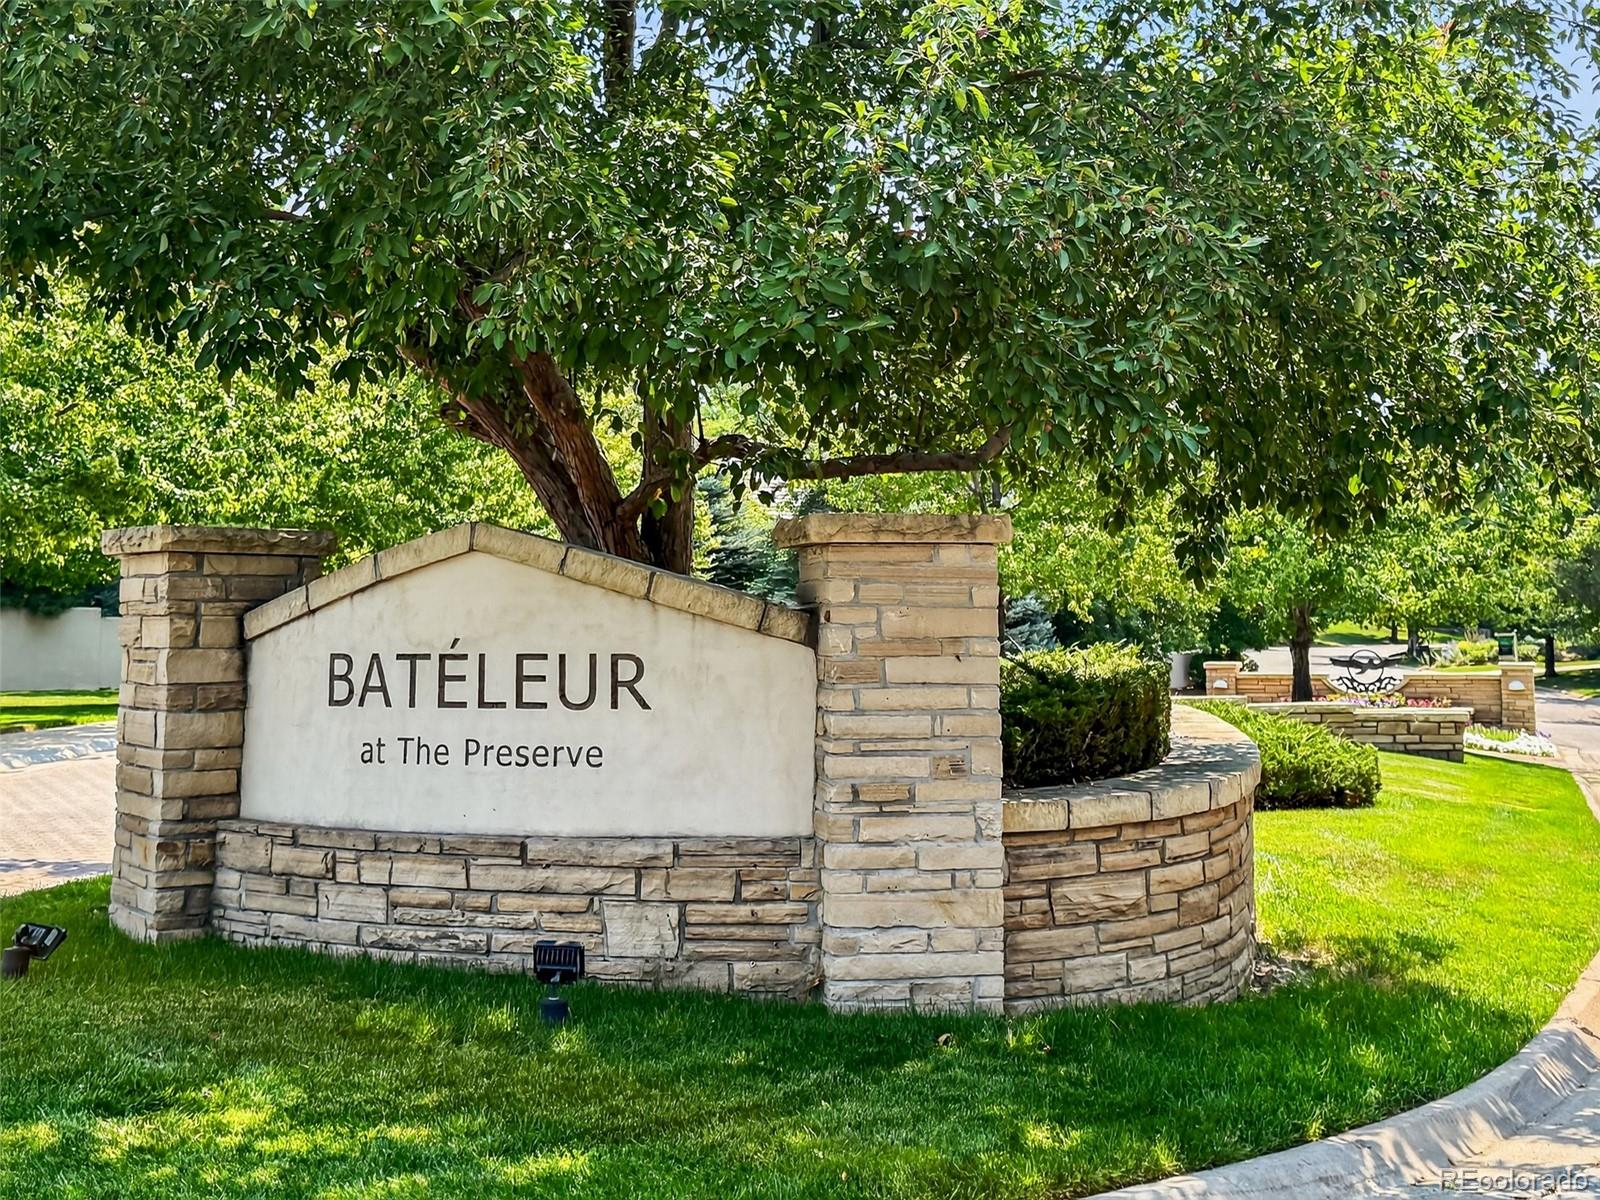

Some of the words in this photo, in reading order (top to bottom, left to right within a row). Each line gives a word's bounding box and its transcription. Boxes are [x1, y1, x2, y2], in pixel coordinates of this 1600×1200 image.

[328, 637, 652, 711] BATÉLEUR
[360, 738, 386, 765] at
[397, 736, 449, 766] The
[464, 738, 604, 768] Preserve
